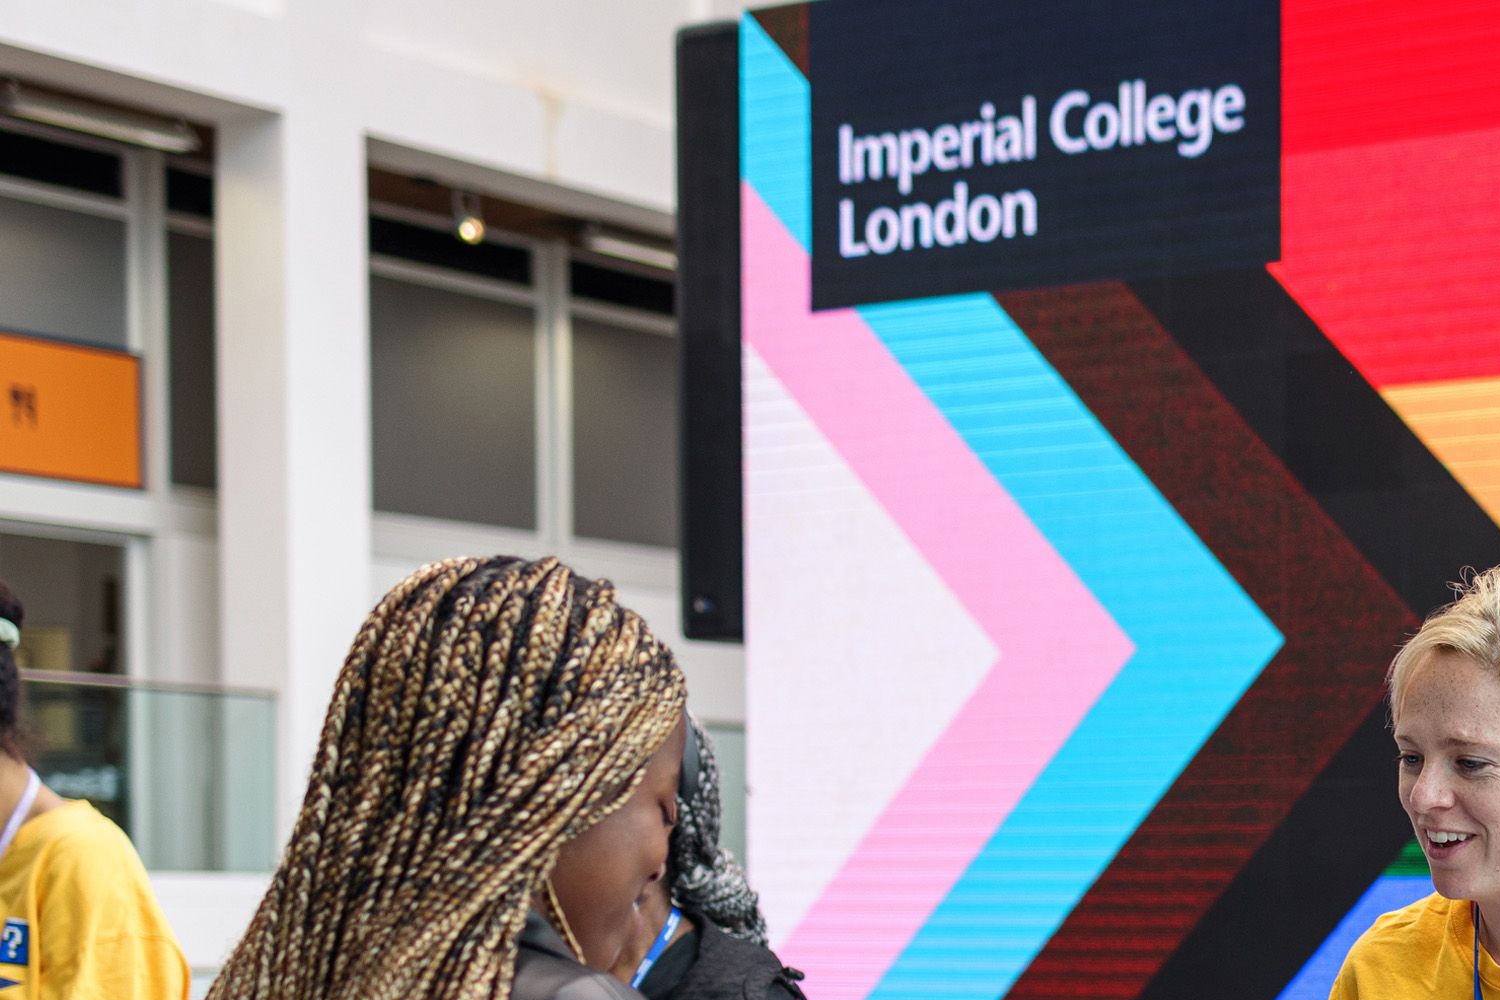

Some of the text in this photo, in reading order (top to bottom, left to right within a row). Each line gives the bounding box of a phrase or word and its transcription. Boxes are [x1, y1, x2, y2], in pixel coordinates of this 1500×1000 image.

[838, 79, 1246, 194] Imperial College
[839, 181, 1037, 257] London
